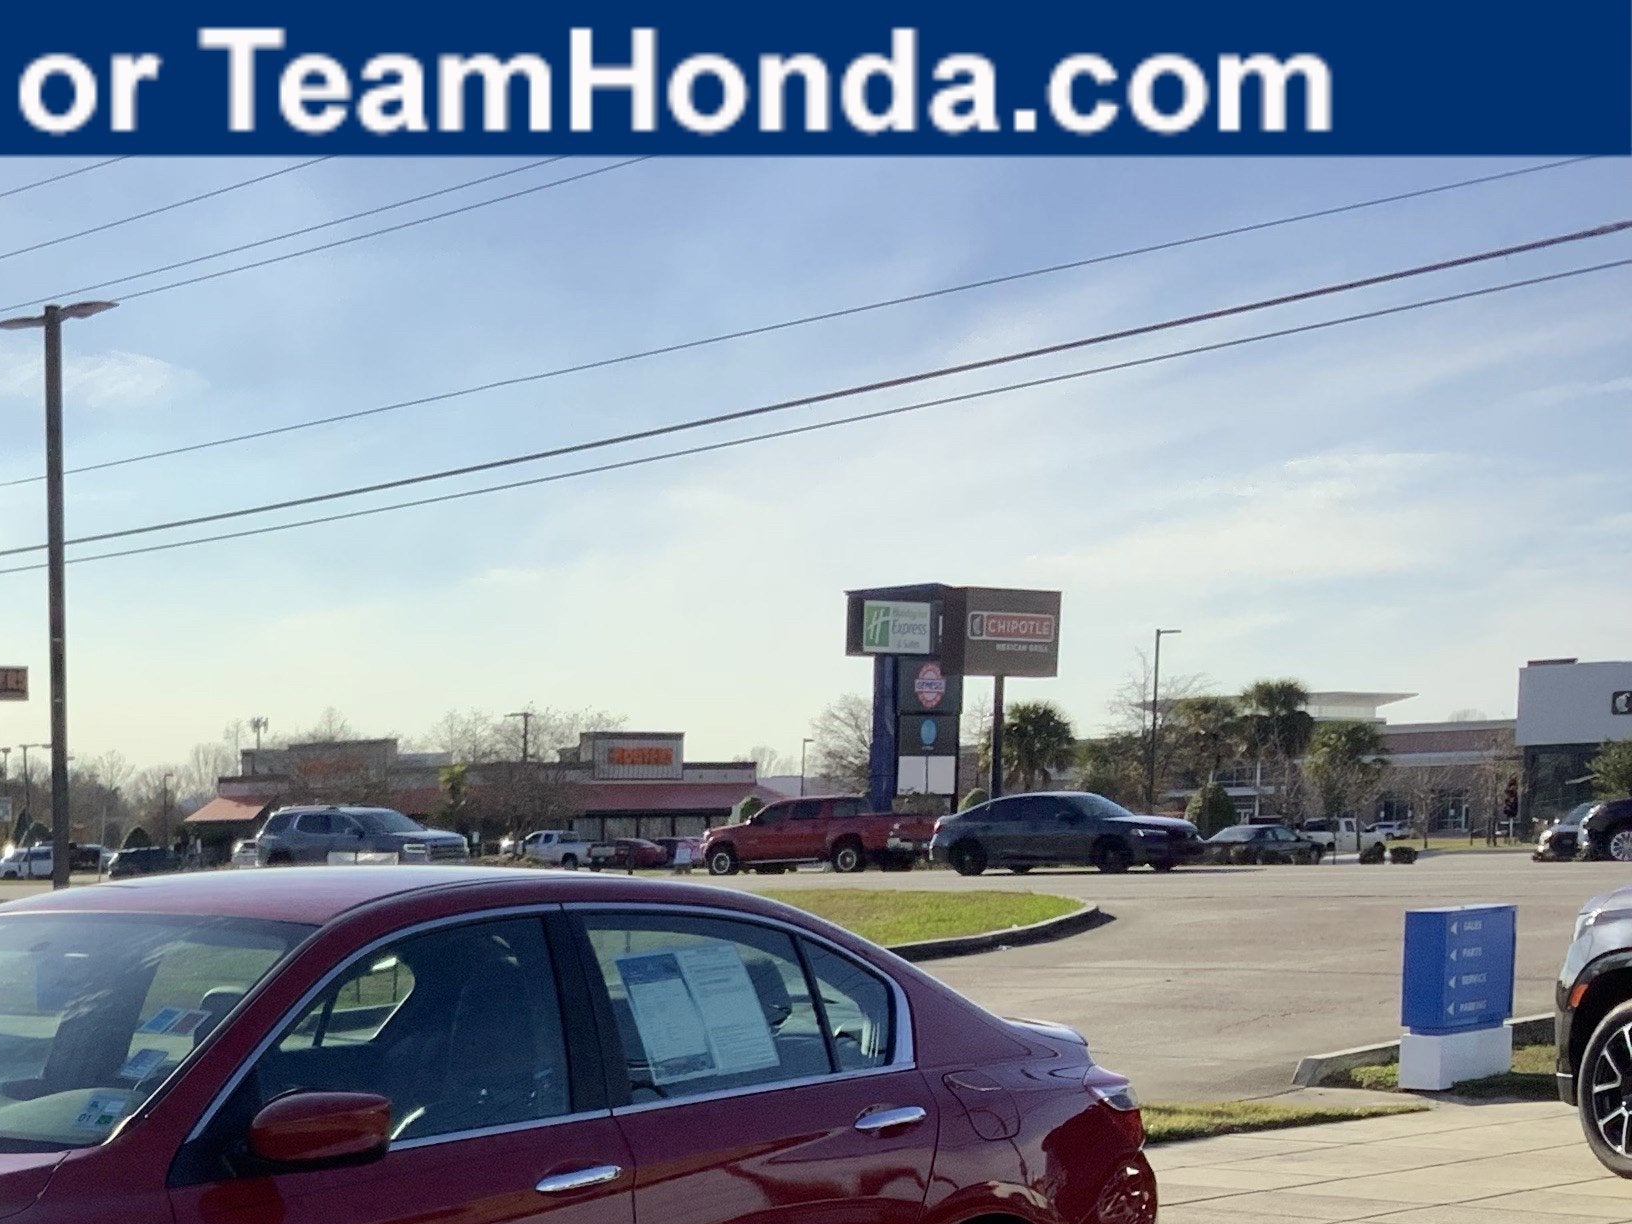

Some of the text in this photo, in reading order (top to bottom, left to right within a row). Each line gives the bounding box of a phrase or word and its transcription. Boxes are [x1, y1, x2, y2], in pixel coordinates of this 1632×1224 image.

[891, 619, 928, 635] Express
[988, 619, 1051, 635] CHIPOTLE
[995, 643, 1027, 651] MEXICAN
